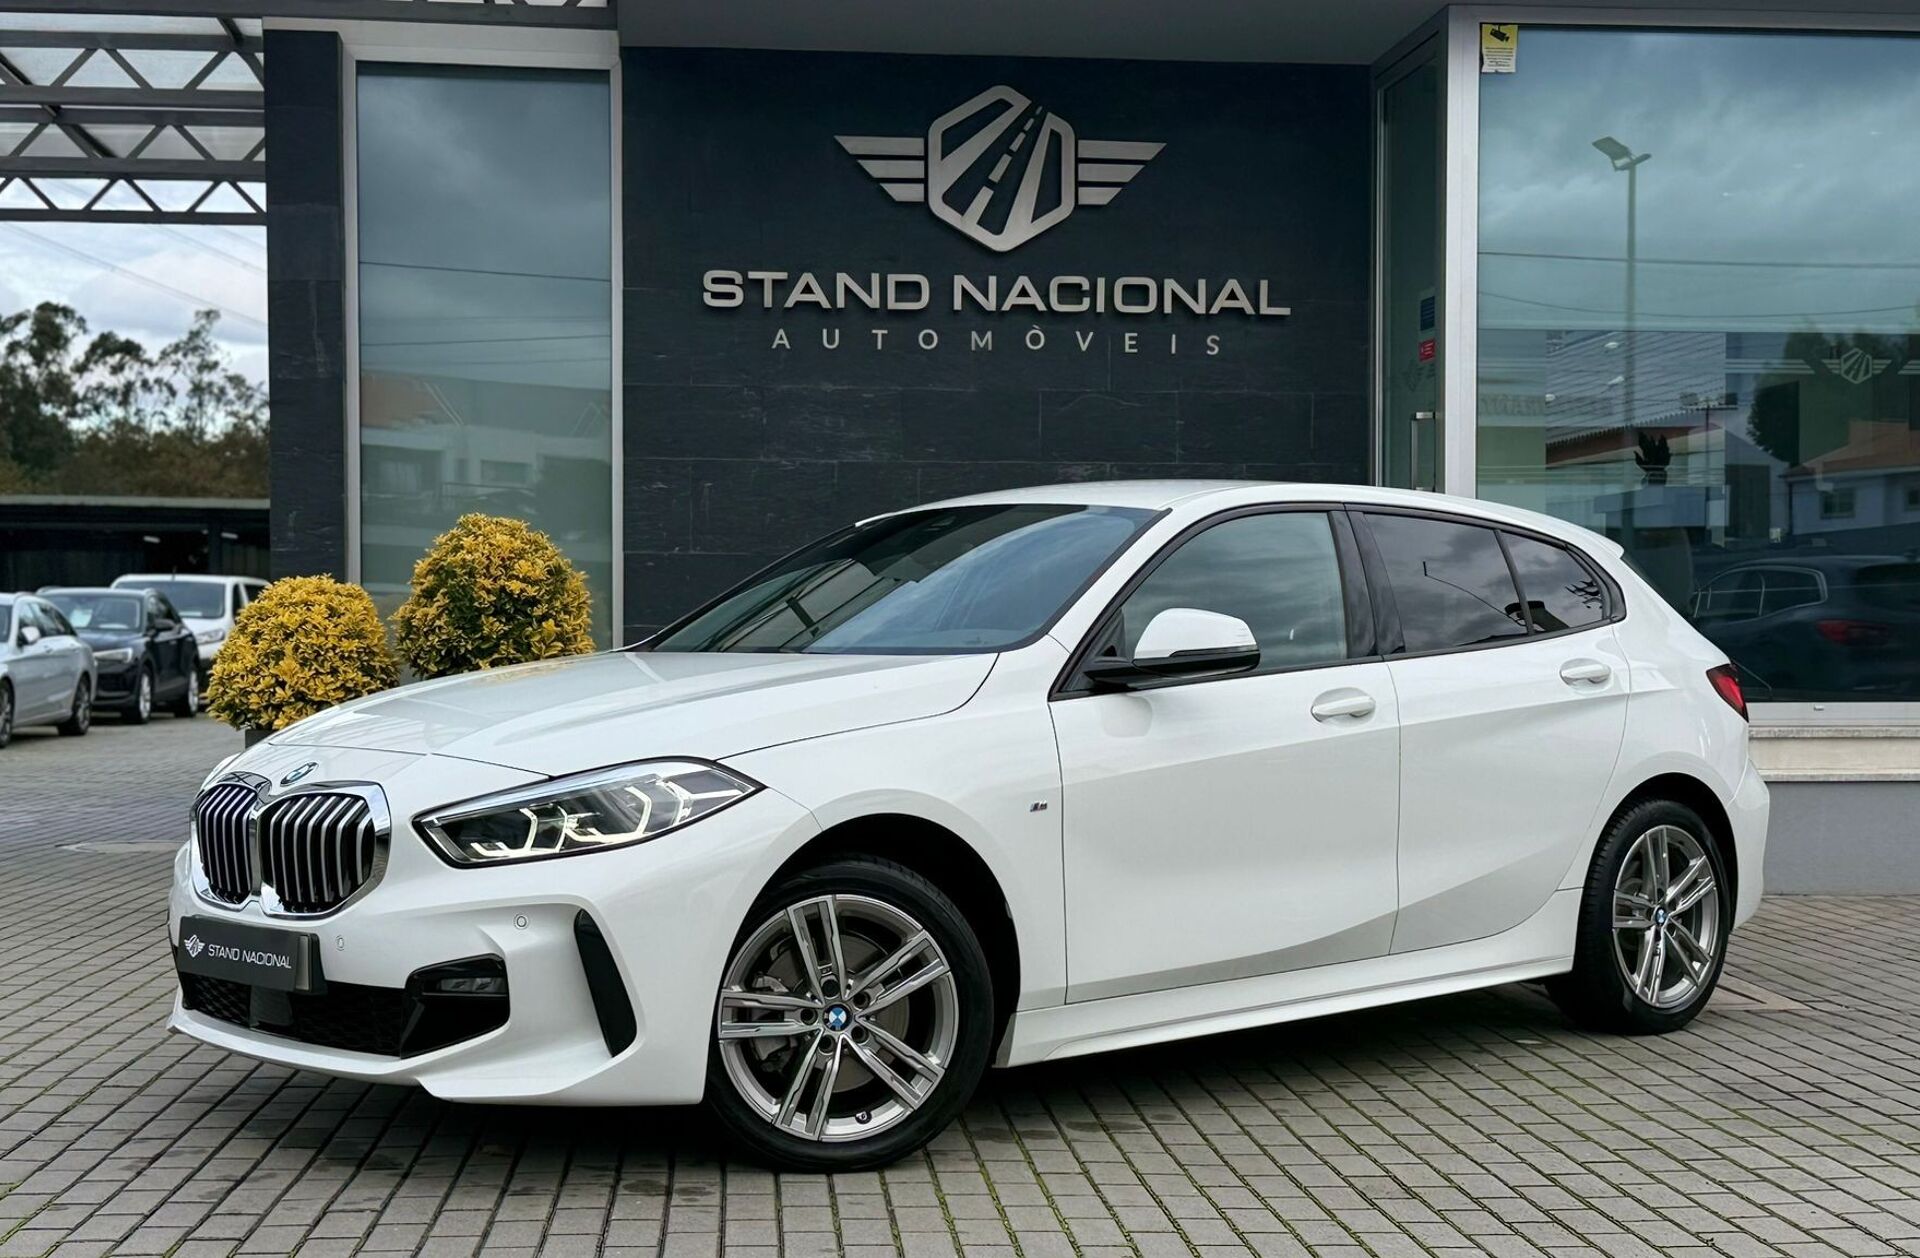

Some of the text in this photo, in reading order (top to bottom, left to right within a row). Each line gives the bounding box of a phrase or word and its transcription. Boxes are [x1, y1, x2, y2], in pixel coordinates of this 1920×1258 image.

[702, 270, 1292, 316] STAND NACIONAL
[208, 944, 291, 968] STAND NACIONAL
